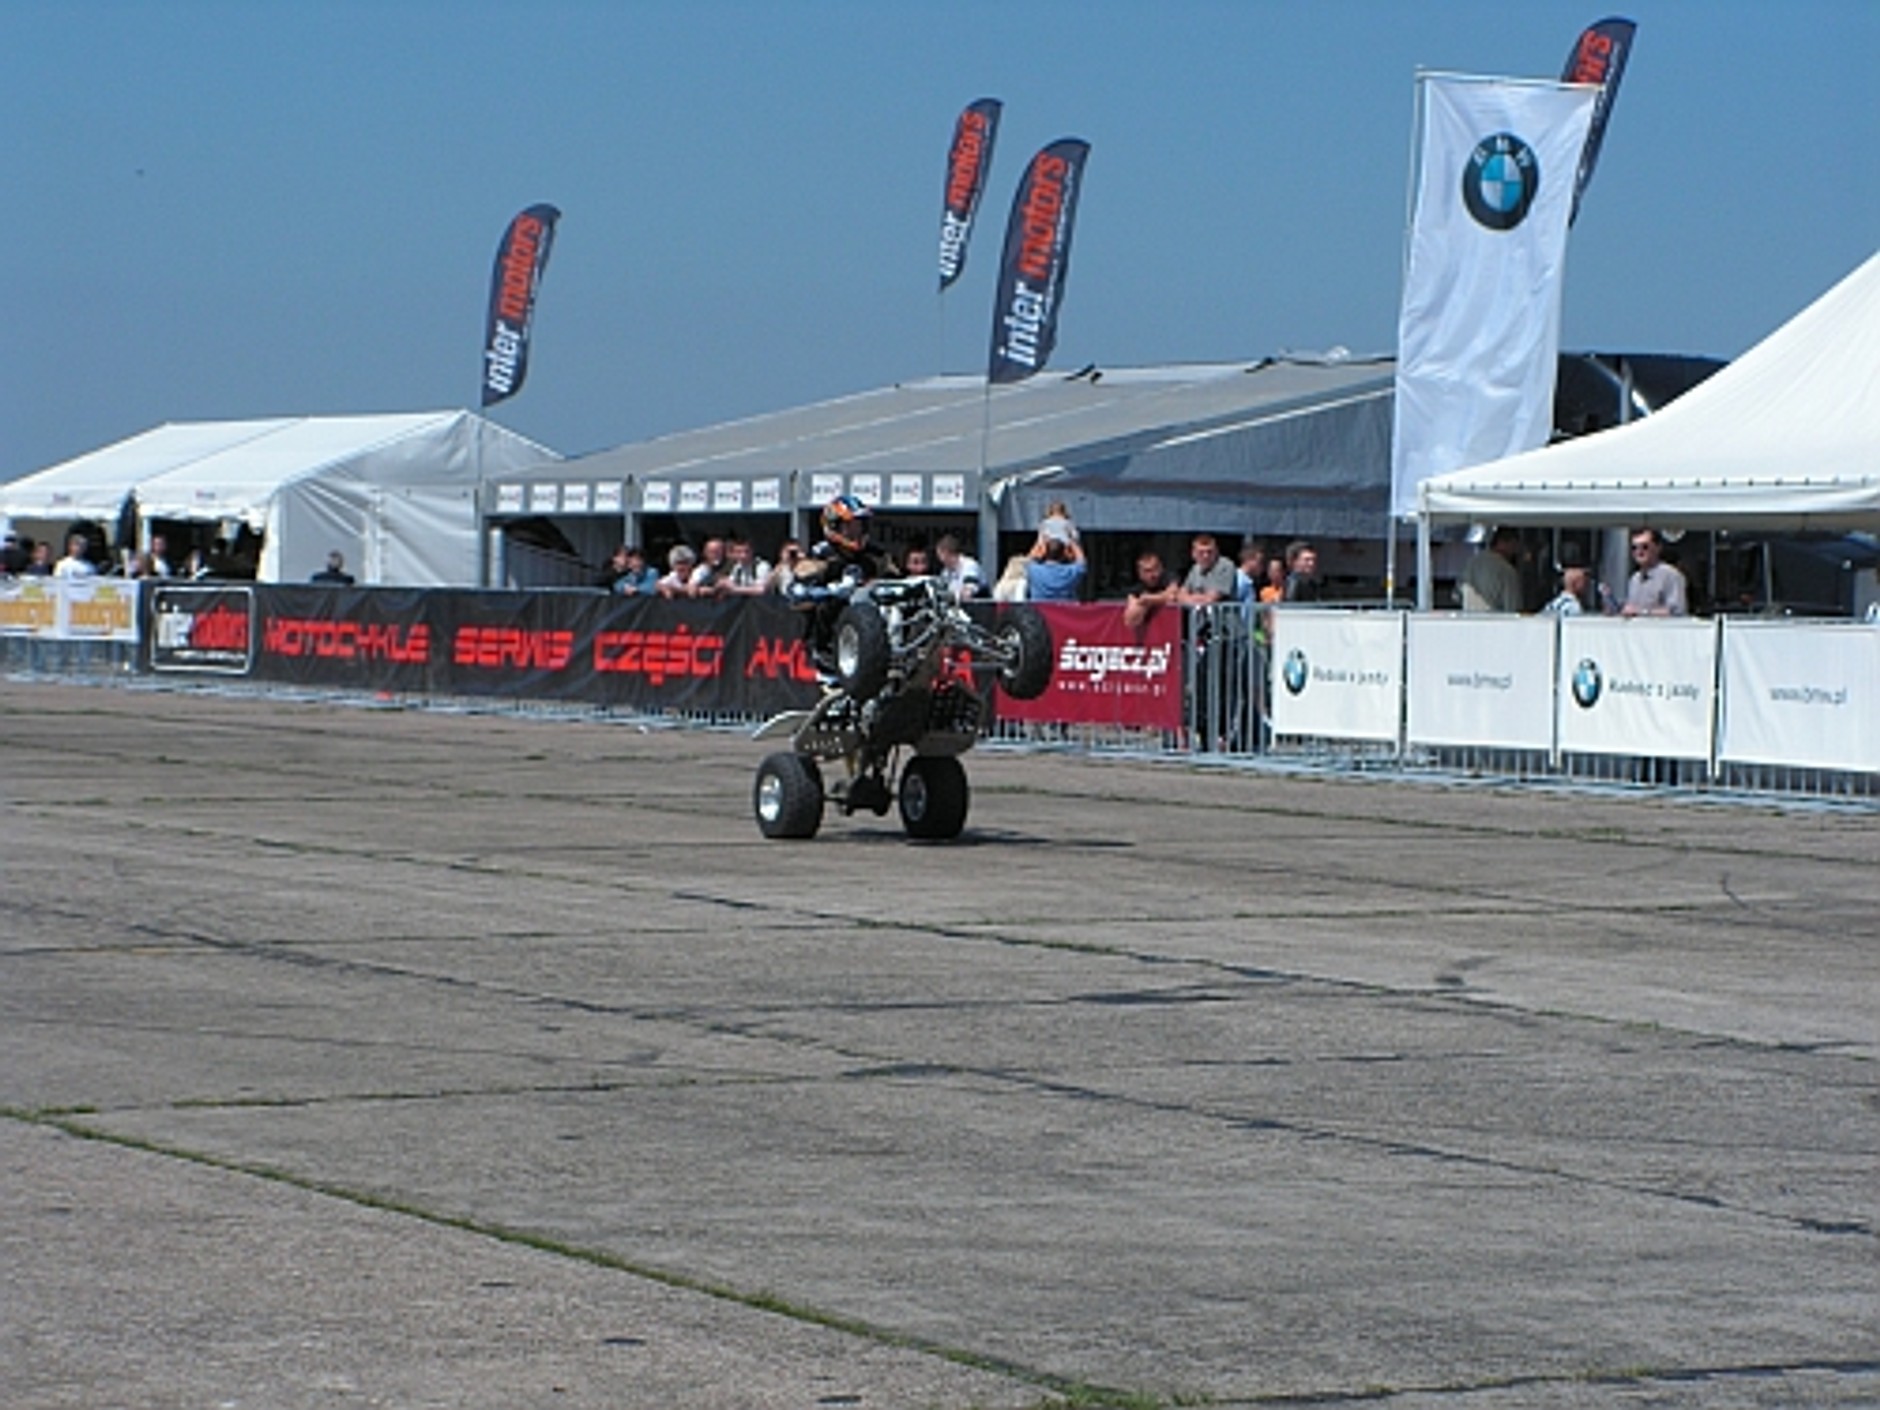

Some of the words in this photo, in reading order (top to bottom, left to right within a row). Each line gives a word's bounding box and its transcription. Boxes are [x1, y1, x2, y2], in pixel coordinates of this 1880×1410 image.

[946, 110, 987, 208] motors
[1017, 151, 1069, 279] motors
[499, 213, 543, 320] motors
[999, 281, 1044, 367] inter
[454, 626, 575, 670] SERWIS
